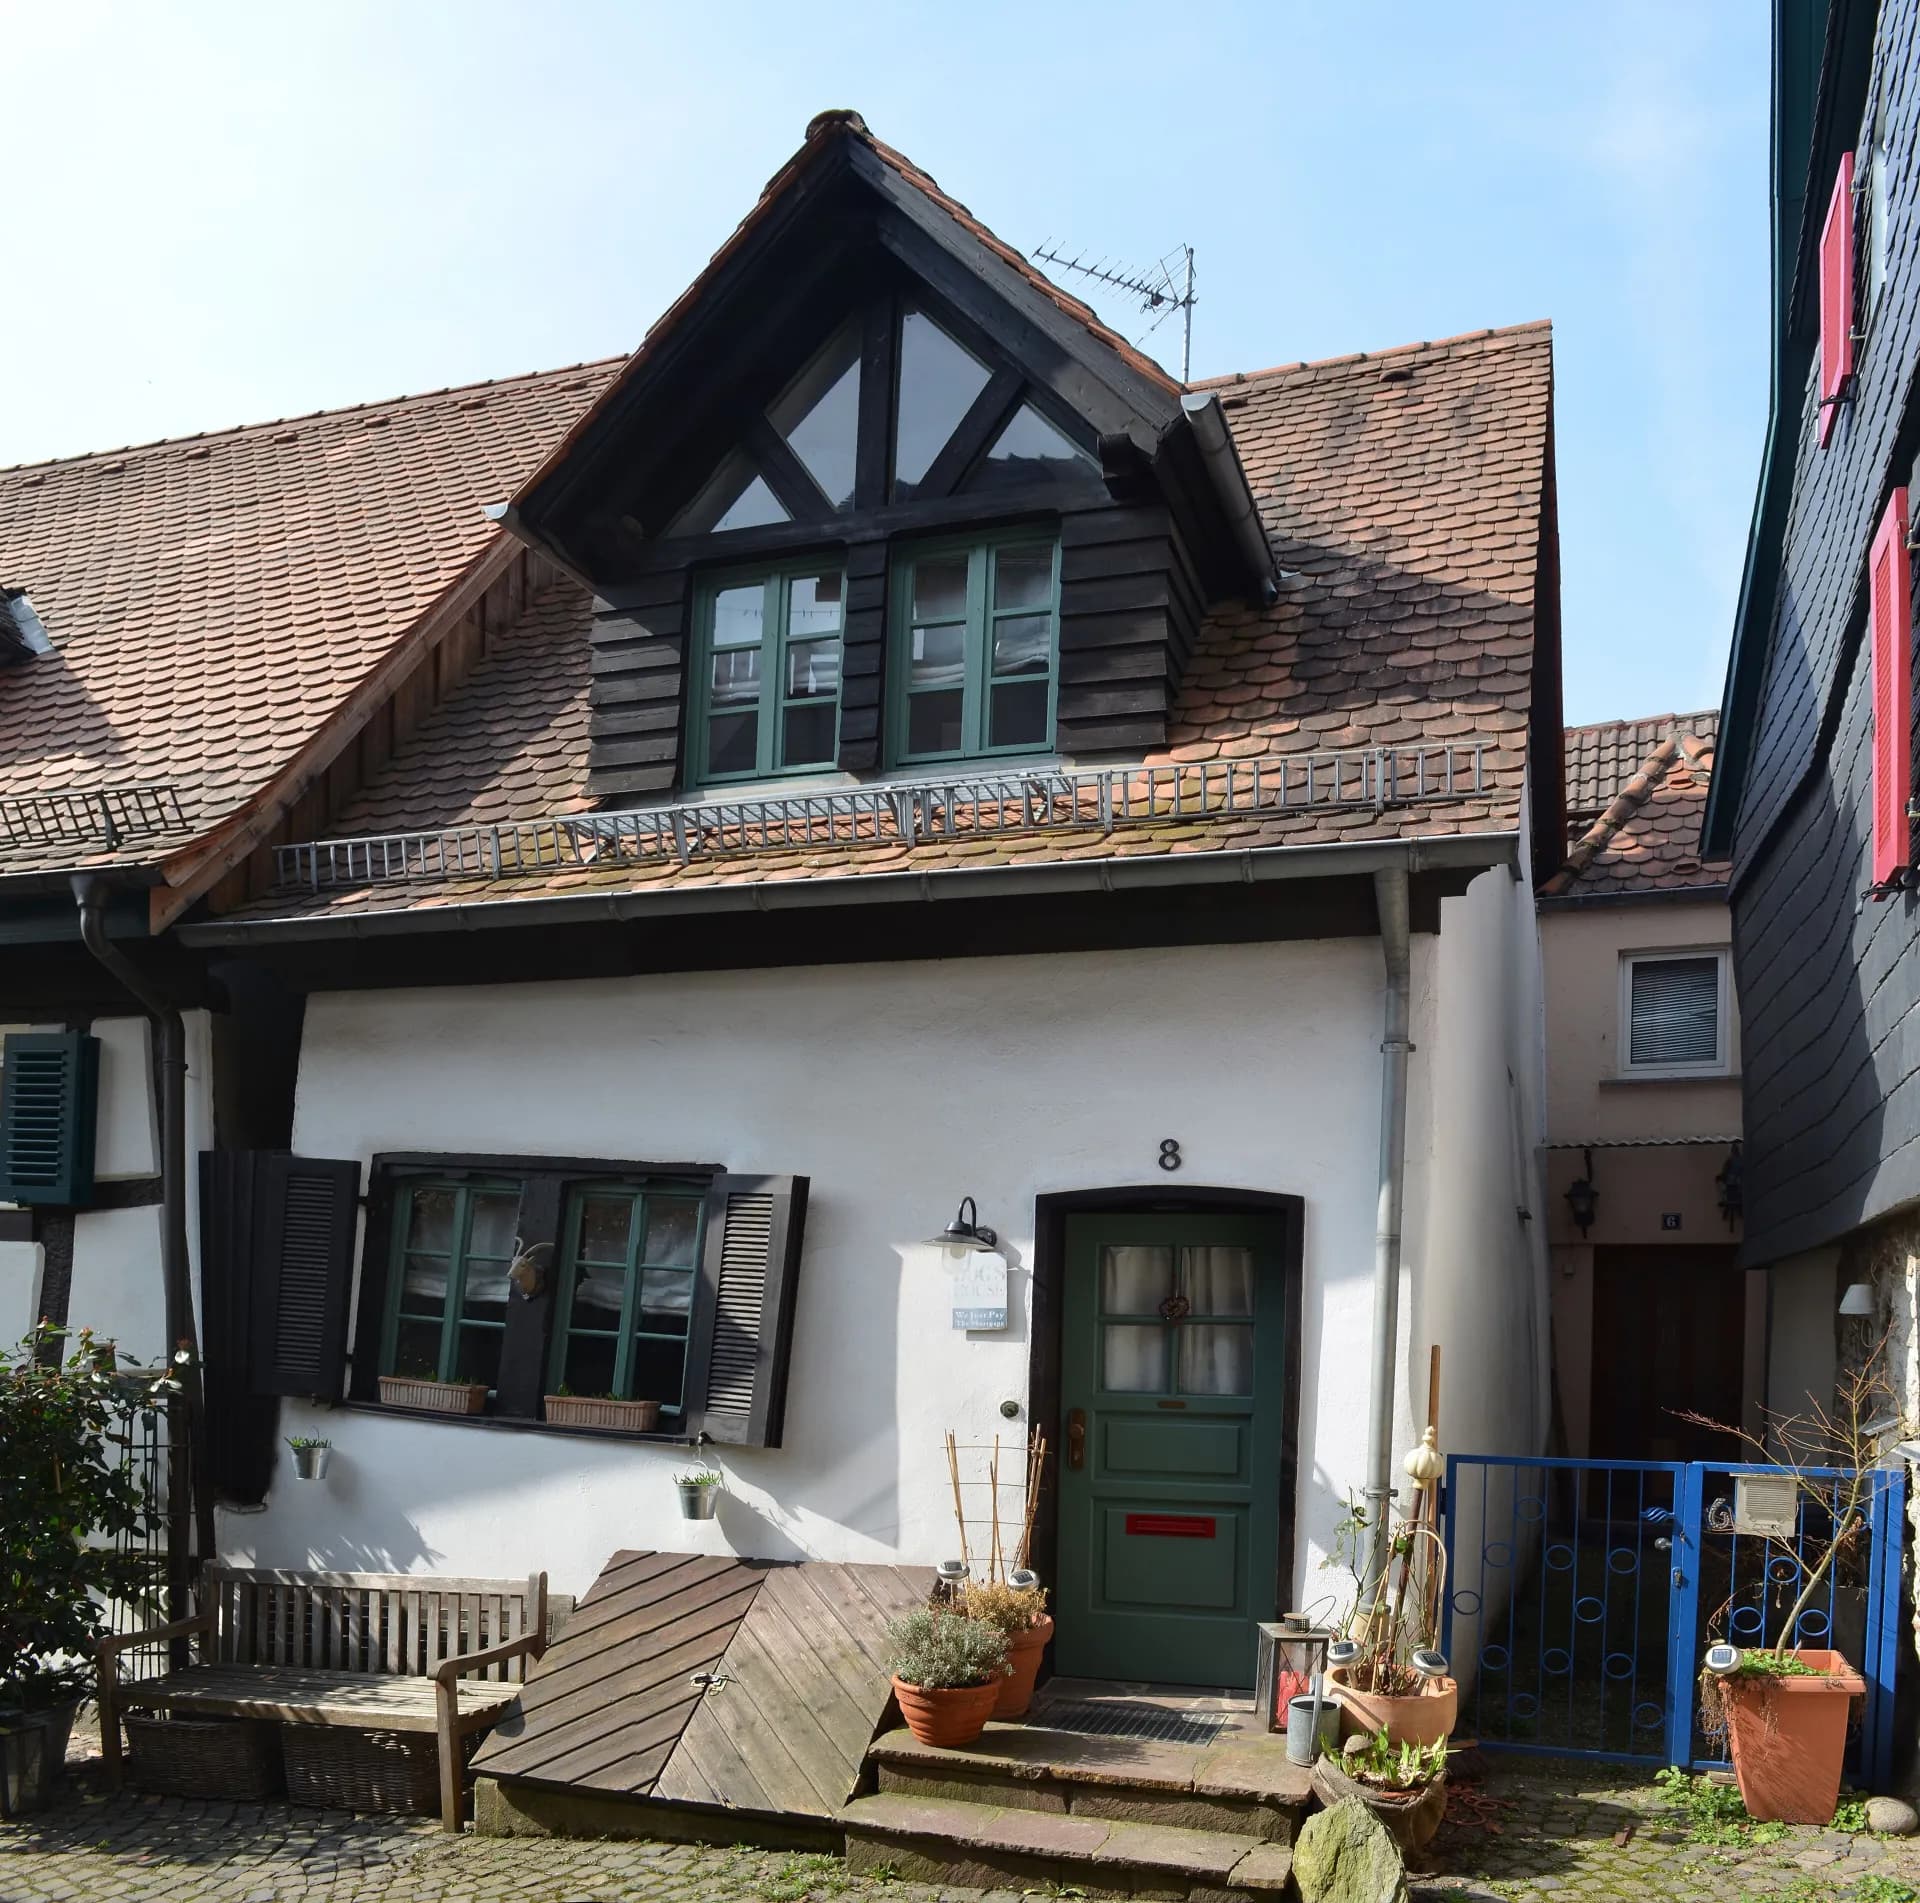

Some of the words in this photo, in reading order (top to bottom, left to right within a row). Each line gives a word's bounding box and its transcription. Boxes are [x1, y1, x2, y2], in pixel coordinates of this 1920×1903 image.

[1158, 1138, 1182, 1171] 8
[1666, 1215, 1677, 1227] 6
[989, 1311, 1005, 1320] Pay
